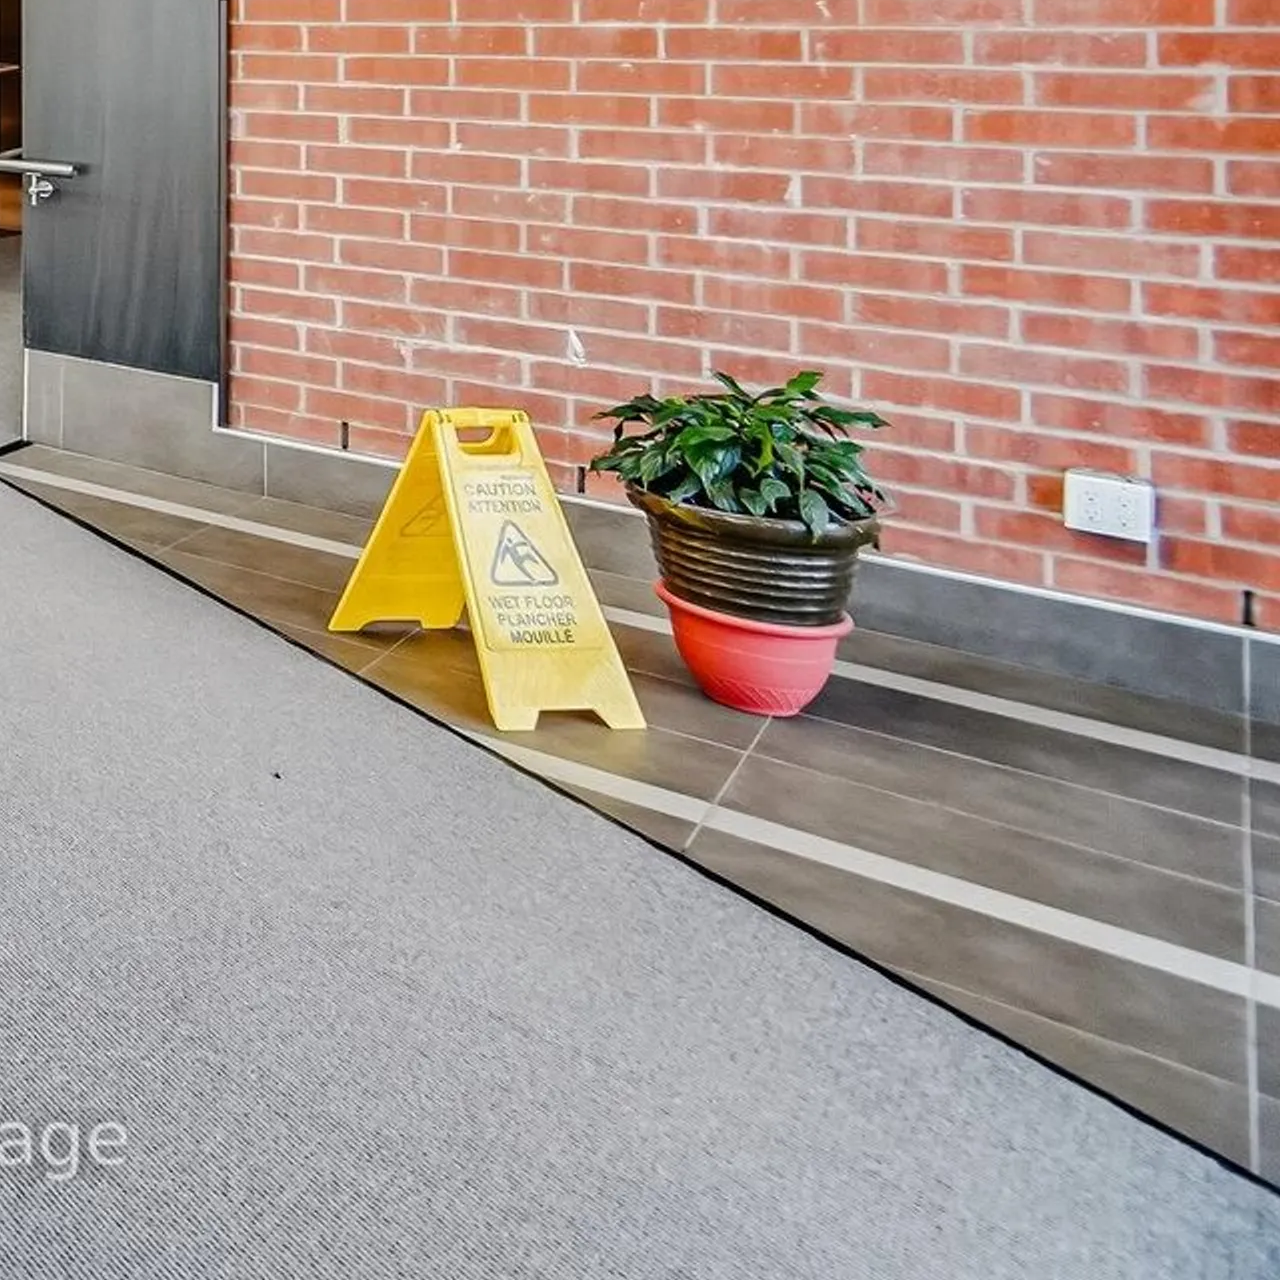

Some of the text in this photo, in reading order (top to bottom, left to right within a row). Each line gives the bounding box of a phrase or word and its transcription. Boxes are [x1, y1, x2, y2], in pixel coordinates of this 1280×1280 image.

[464, 483, 536, 496] CAUTION
[468, 500, 542, 513] ATTENTION
[488, 595, 573, 609] WET FLOOR
[498, 613, 577, 626] PLANCHER
